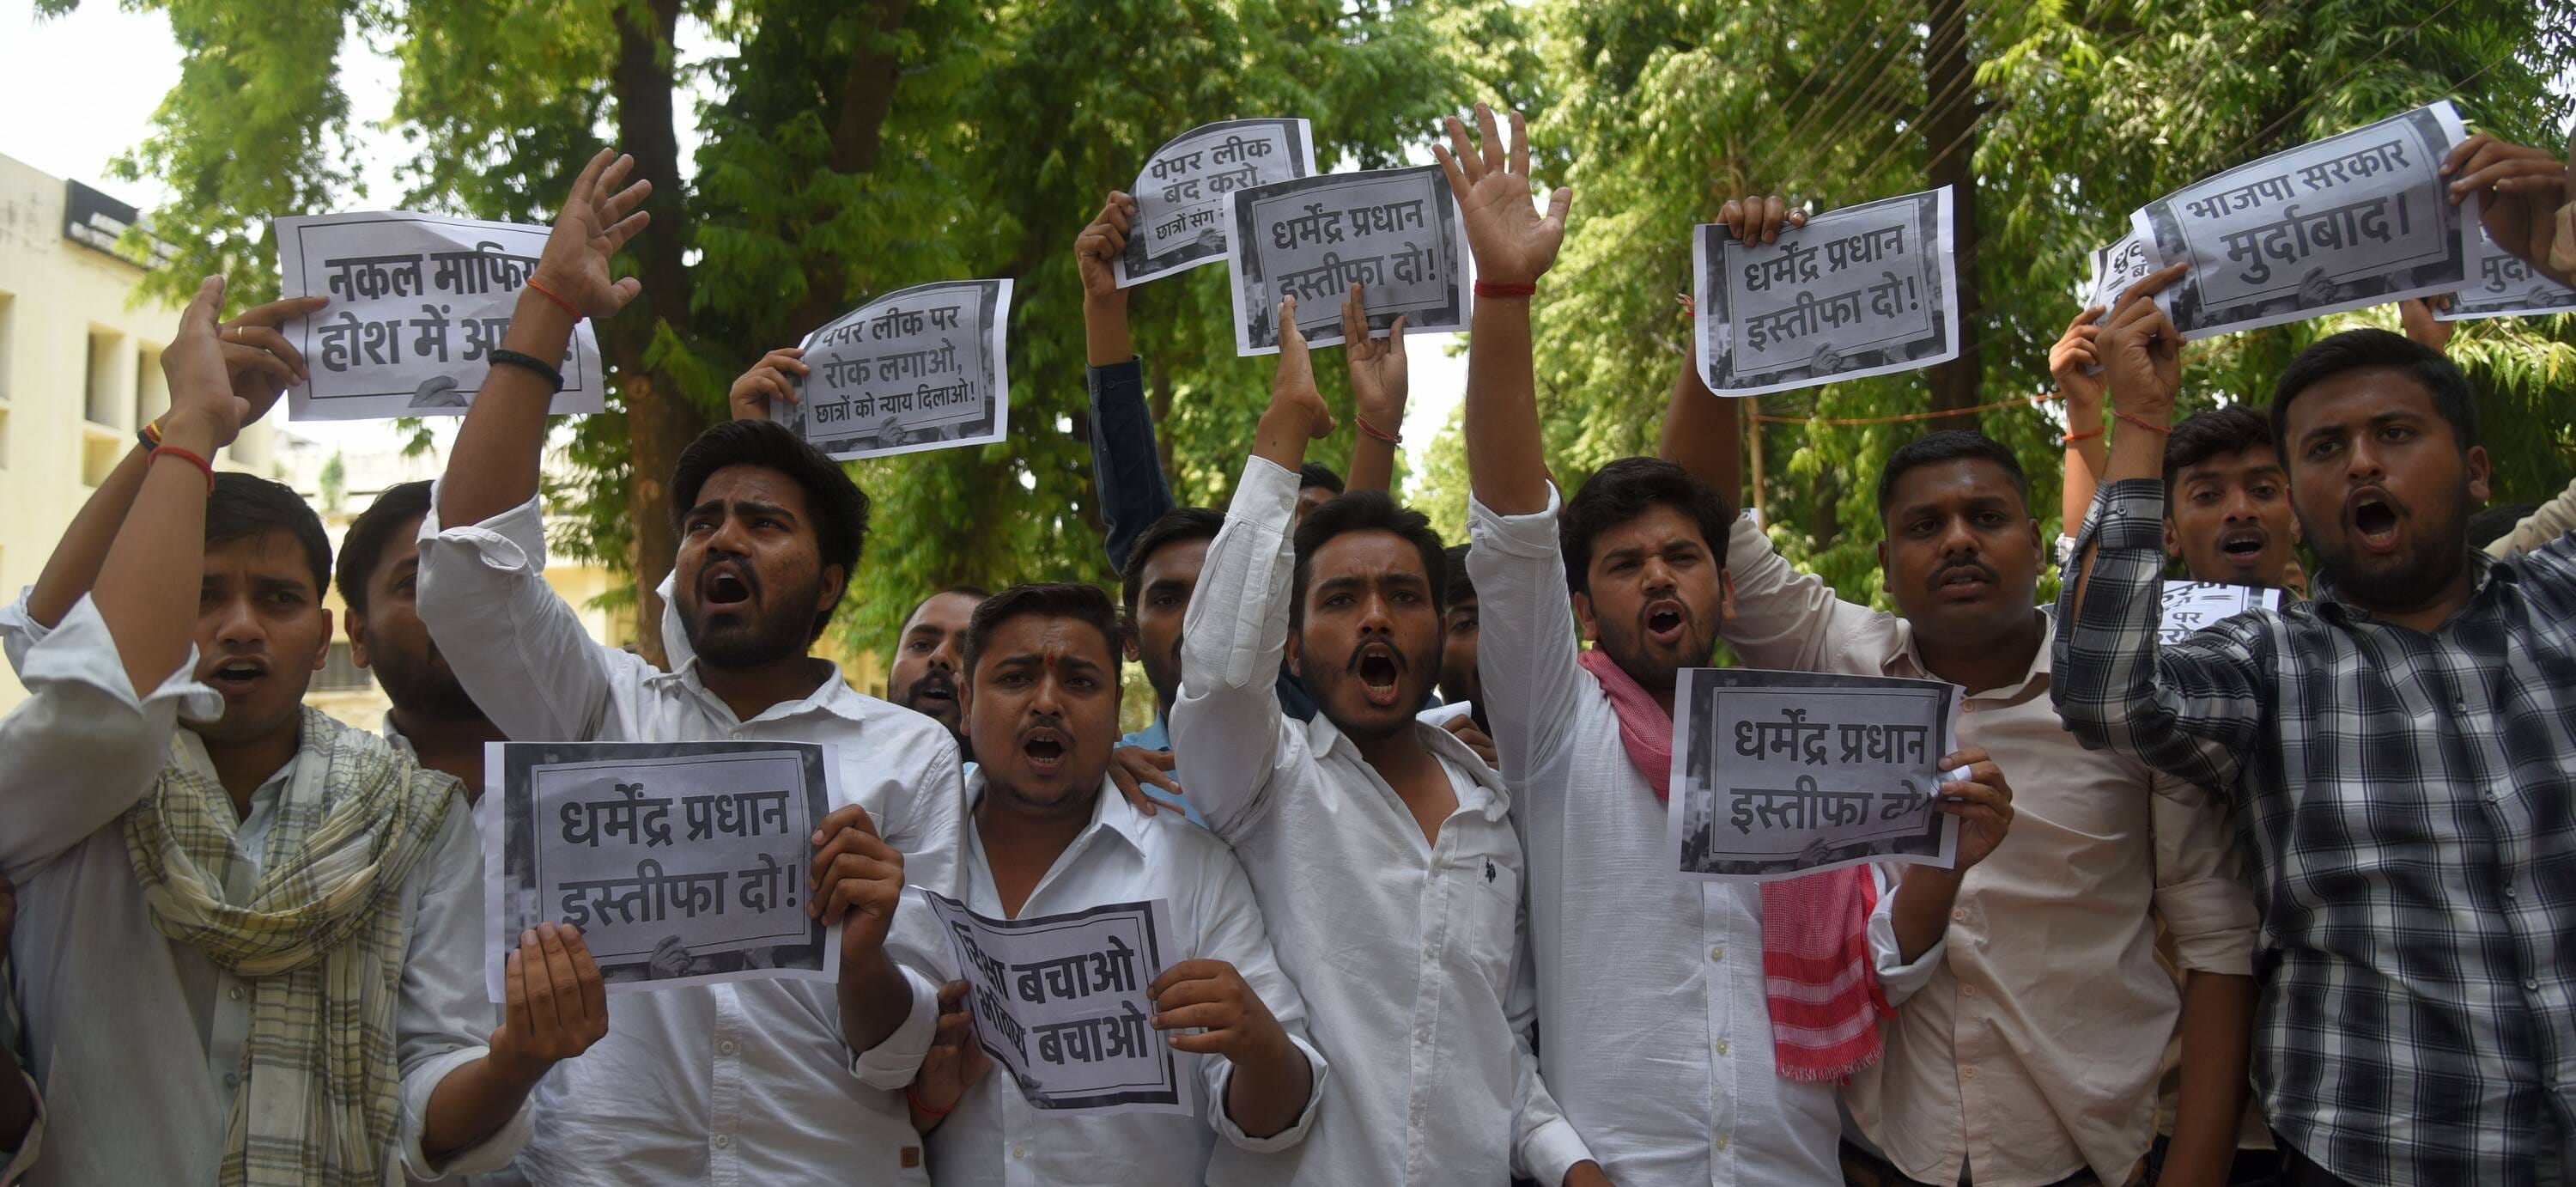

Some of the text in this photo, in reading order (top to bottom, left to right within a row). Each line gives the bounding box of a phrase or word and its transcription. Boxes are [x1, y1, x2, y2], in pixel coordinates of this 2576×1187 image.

[1151, 135, 1272, 180] पेपर लीक
[2185, 139, 2410, 219] भाजपा सरकार
[1162, 177, 1201, 204] बंद
[1155, 213, 1187, 240] छात्रों
[1189, 209, 1214, 228] संग
[1272, 198, 1424, 251] धर्मेंद्र प्रधान
[325, 253, 423, 301] नकल
[1277, 241, 1436, 302] इस्तीफा दो!
[1744, 224, 1905, 292] धर्मेंद्र प्रधान
[318, 311, 401, 372] होश
[410, 304, 452, 362] में
[872, 307, 924, 340] लीक
[929, 306, 961, 331] पर
[1745, 271, 1918, 352] इस्तीफा दो!
[823, 338, 963, 389] रोक लगाओ,
[815, 377, 975, 423] छात्रों को न्याय दिलाओ!
[2172, 612, 2202, 624] पर
[1735, 709, 1928, 765] धर्मेंद्र प्रधान
[560, 783, 790, 848] धर्मेंद्र प्रधान
[1729, 774, 1874, 836] इस्तीफा
[558, 853, 797, 934] इस्तीफा दो!
[1012, 935, 1136, 1004] बचाओ
[1032, 1001, 1148, 1065] बचाओ
